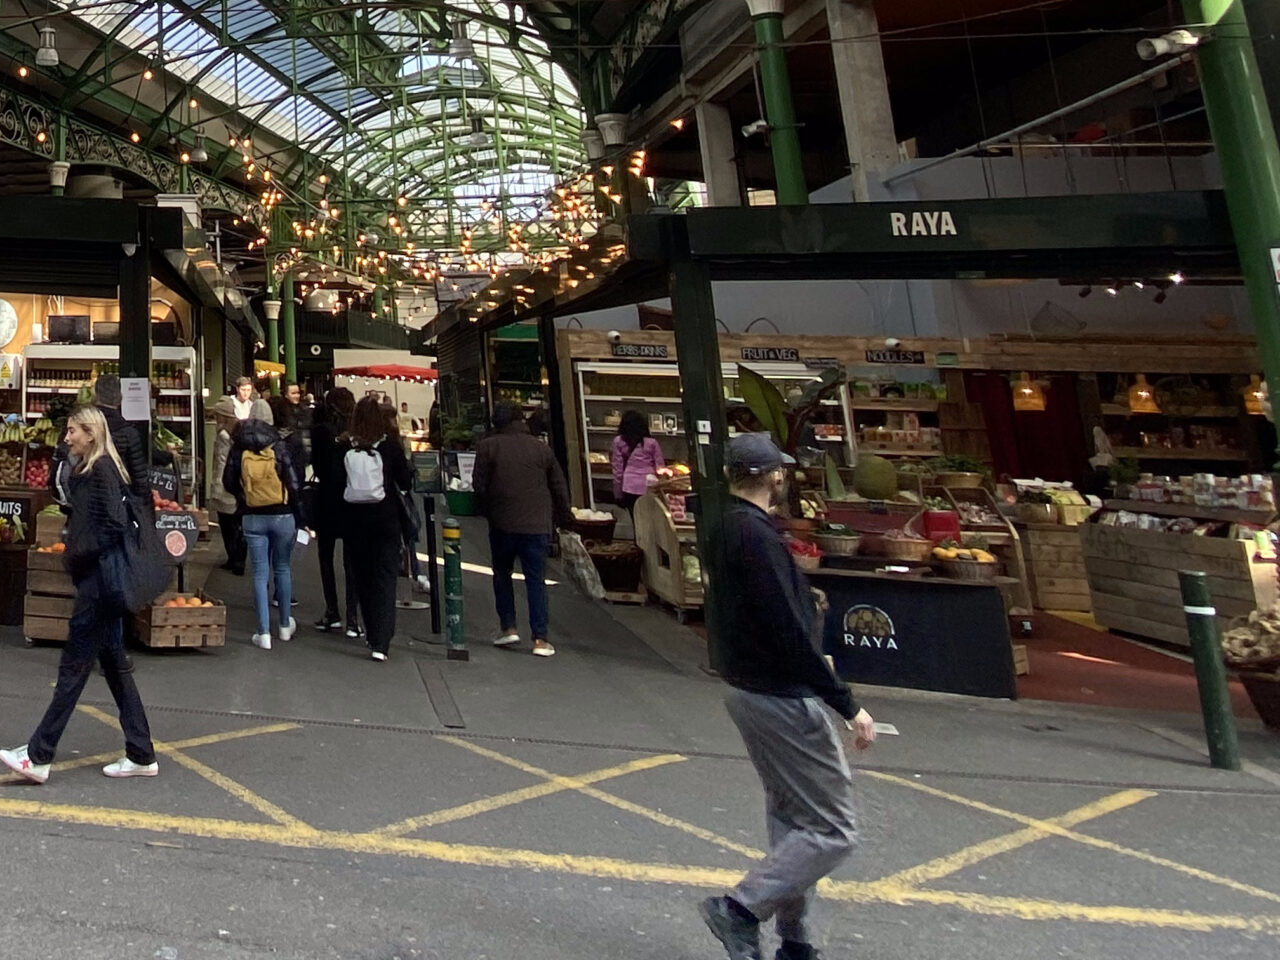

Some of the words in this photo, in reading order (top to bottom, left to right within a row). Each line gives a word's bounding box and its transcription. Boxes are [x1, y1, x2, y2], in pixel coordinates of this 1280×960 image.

[889, 211, 958, 236] RAYA
[742, 348, 769, 360] FRUIT
[776, 348, 798, 361] VEG
[843, 633, 899, 650] RAYA
